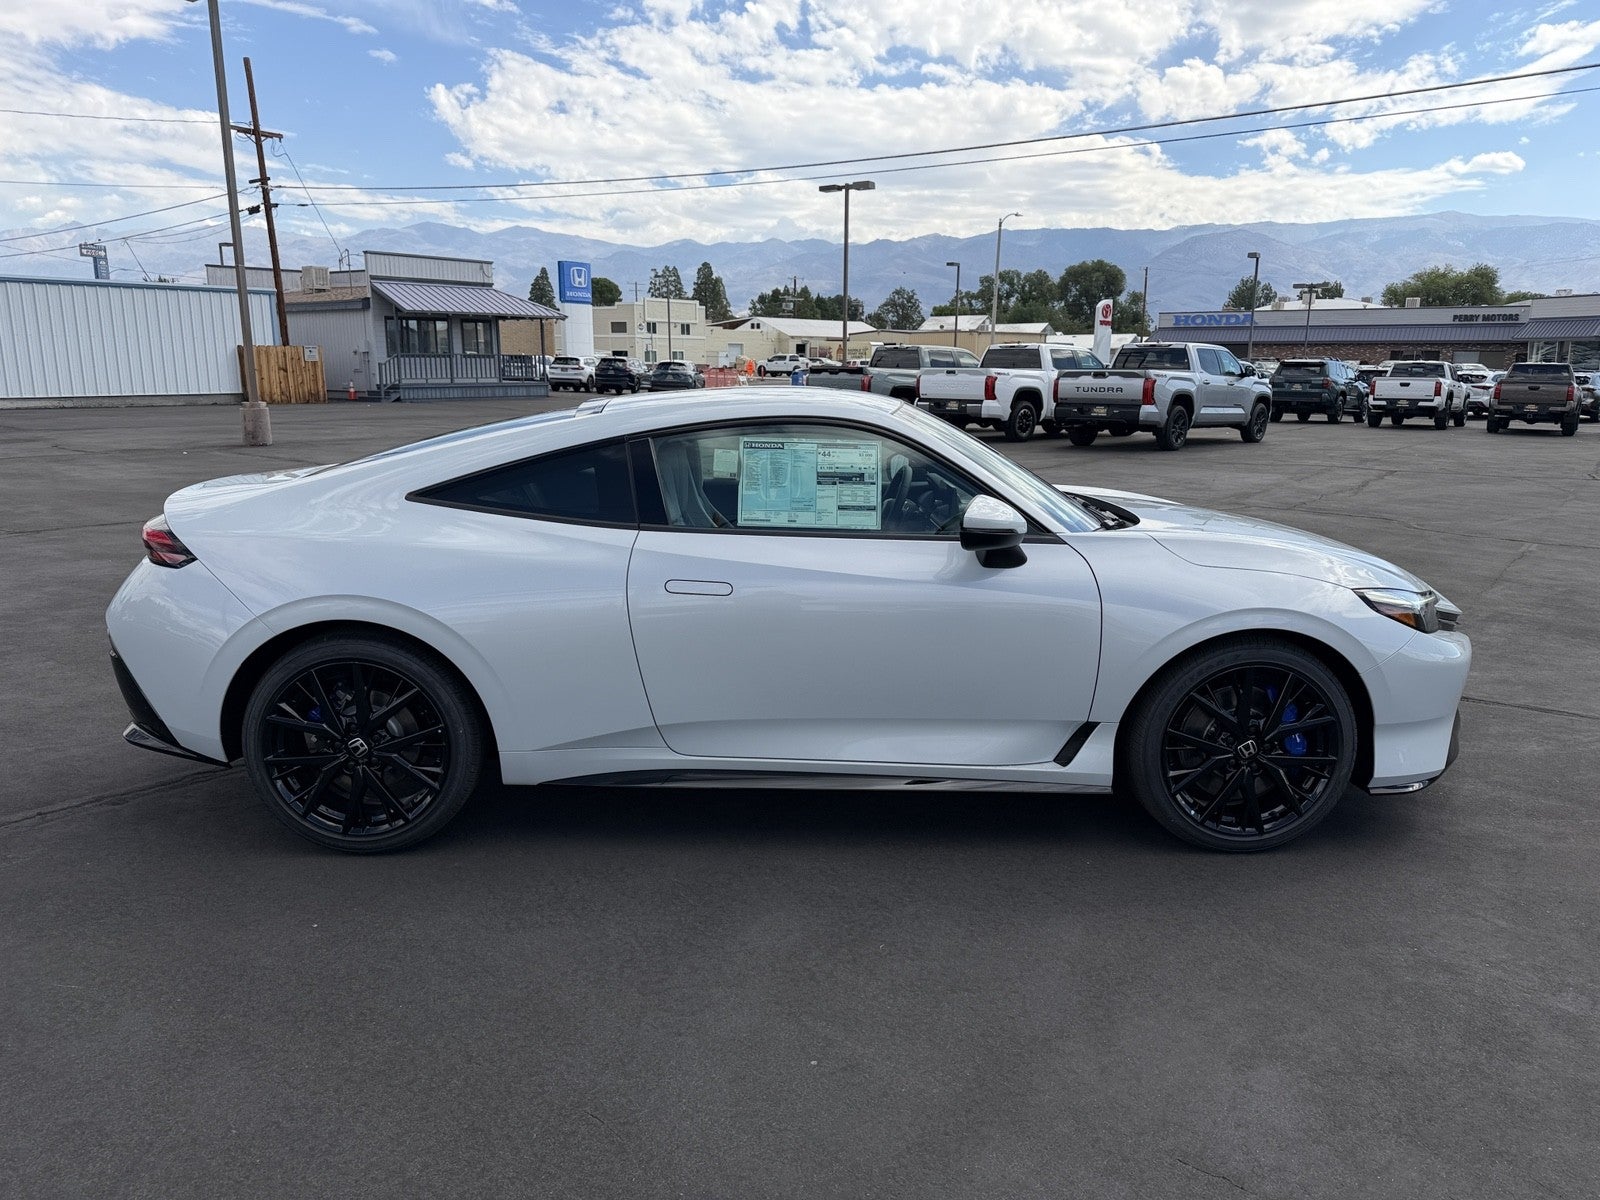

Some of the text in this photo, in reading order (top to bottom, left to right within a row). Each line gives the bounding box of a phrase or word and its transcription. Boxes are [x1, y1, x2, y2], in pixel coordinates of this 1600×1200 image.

[1173, 314, 1258, 326] HONDA
[1452, 313, 1520, 322] PERRY MOTORS
